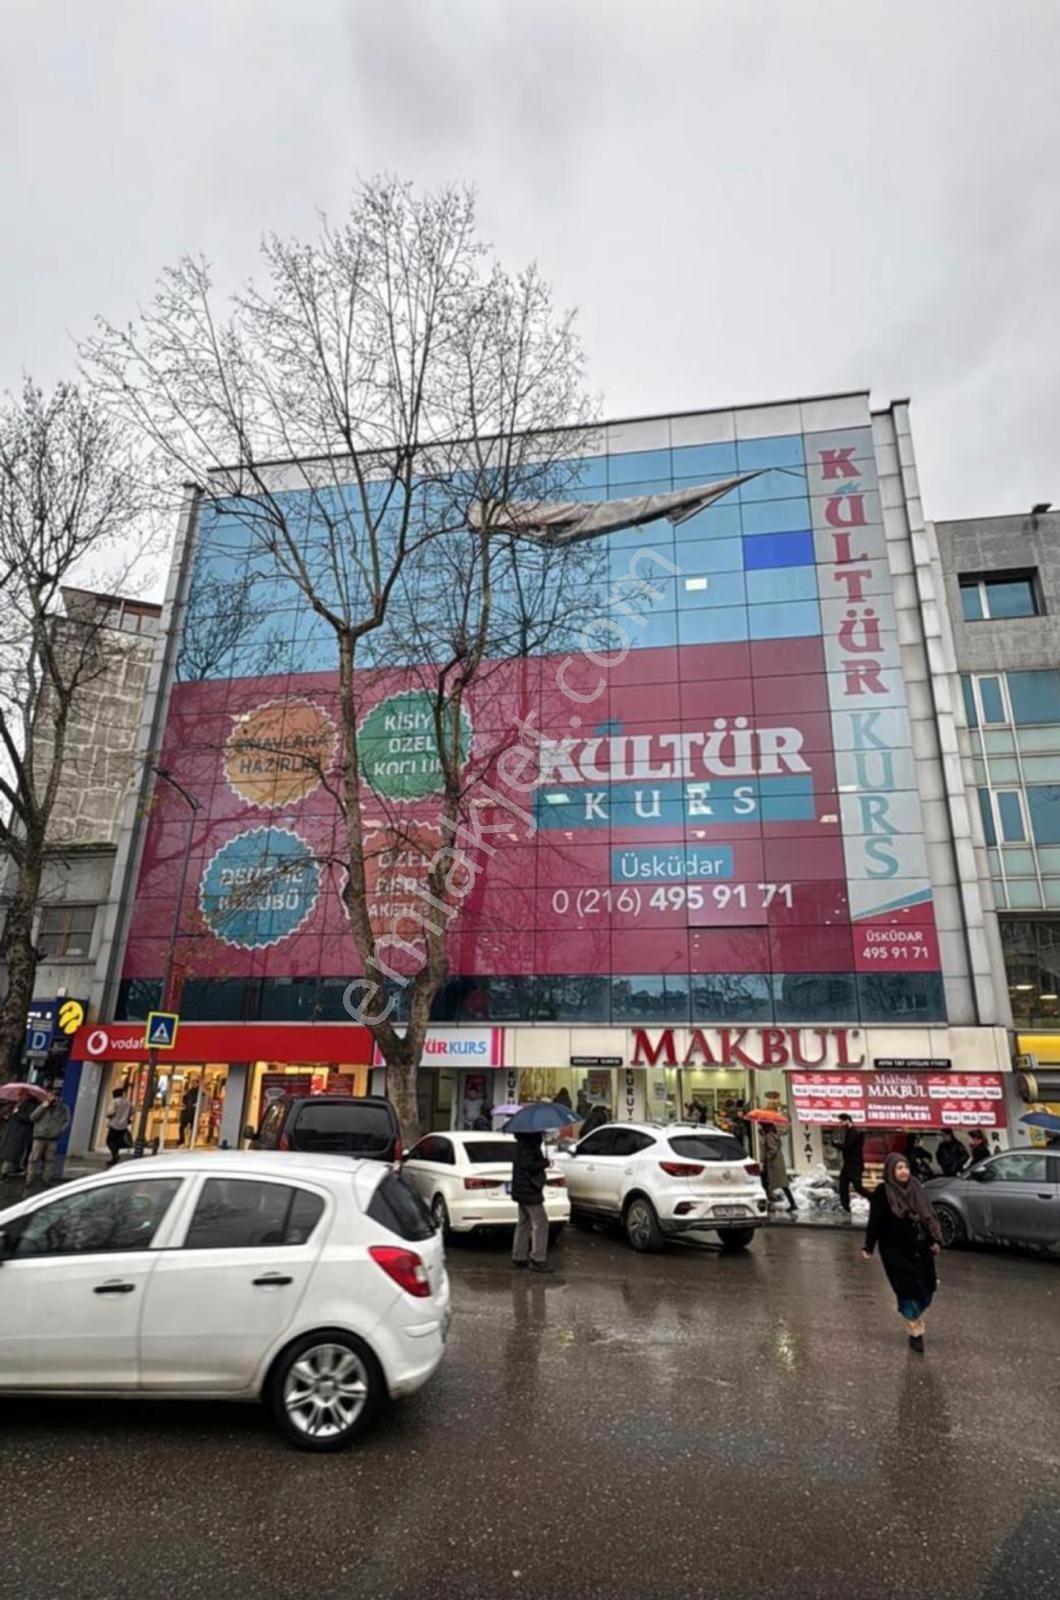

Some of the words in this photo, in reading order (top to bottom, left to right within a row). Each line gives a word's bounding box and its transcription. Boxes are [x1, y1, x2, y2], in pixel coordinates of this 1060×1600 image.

[584, 786, 756, 820] KURS
[850, 711, 900, 880] KURS
[621, 852, 724, 878] Üsküdar
[552, 890, 569, 914] 0
[576, 888, 641, 918] (216)
[650, 884, 703, 912] 495
[713, 883, 747, 909] 91
[757, 883, 793, 908] 71
[866, 929, 923, 942] ÜSKÜDAR
[863, 948, 888, 960] 495
[891, 947, 908, 960] 91
[913, 946, 929, 959] 71
[111, 1038, 145, 1050] vodaf
[630, 1027, 865, 1070] MAKBUL
[867, 1085, 928, 1099] MAKBUL
